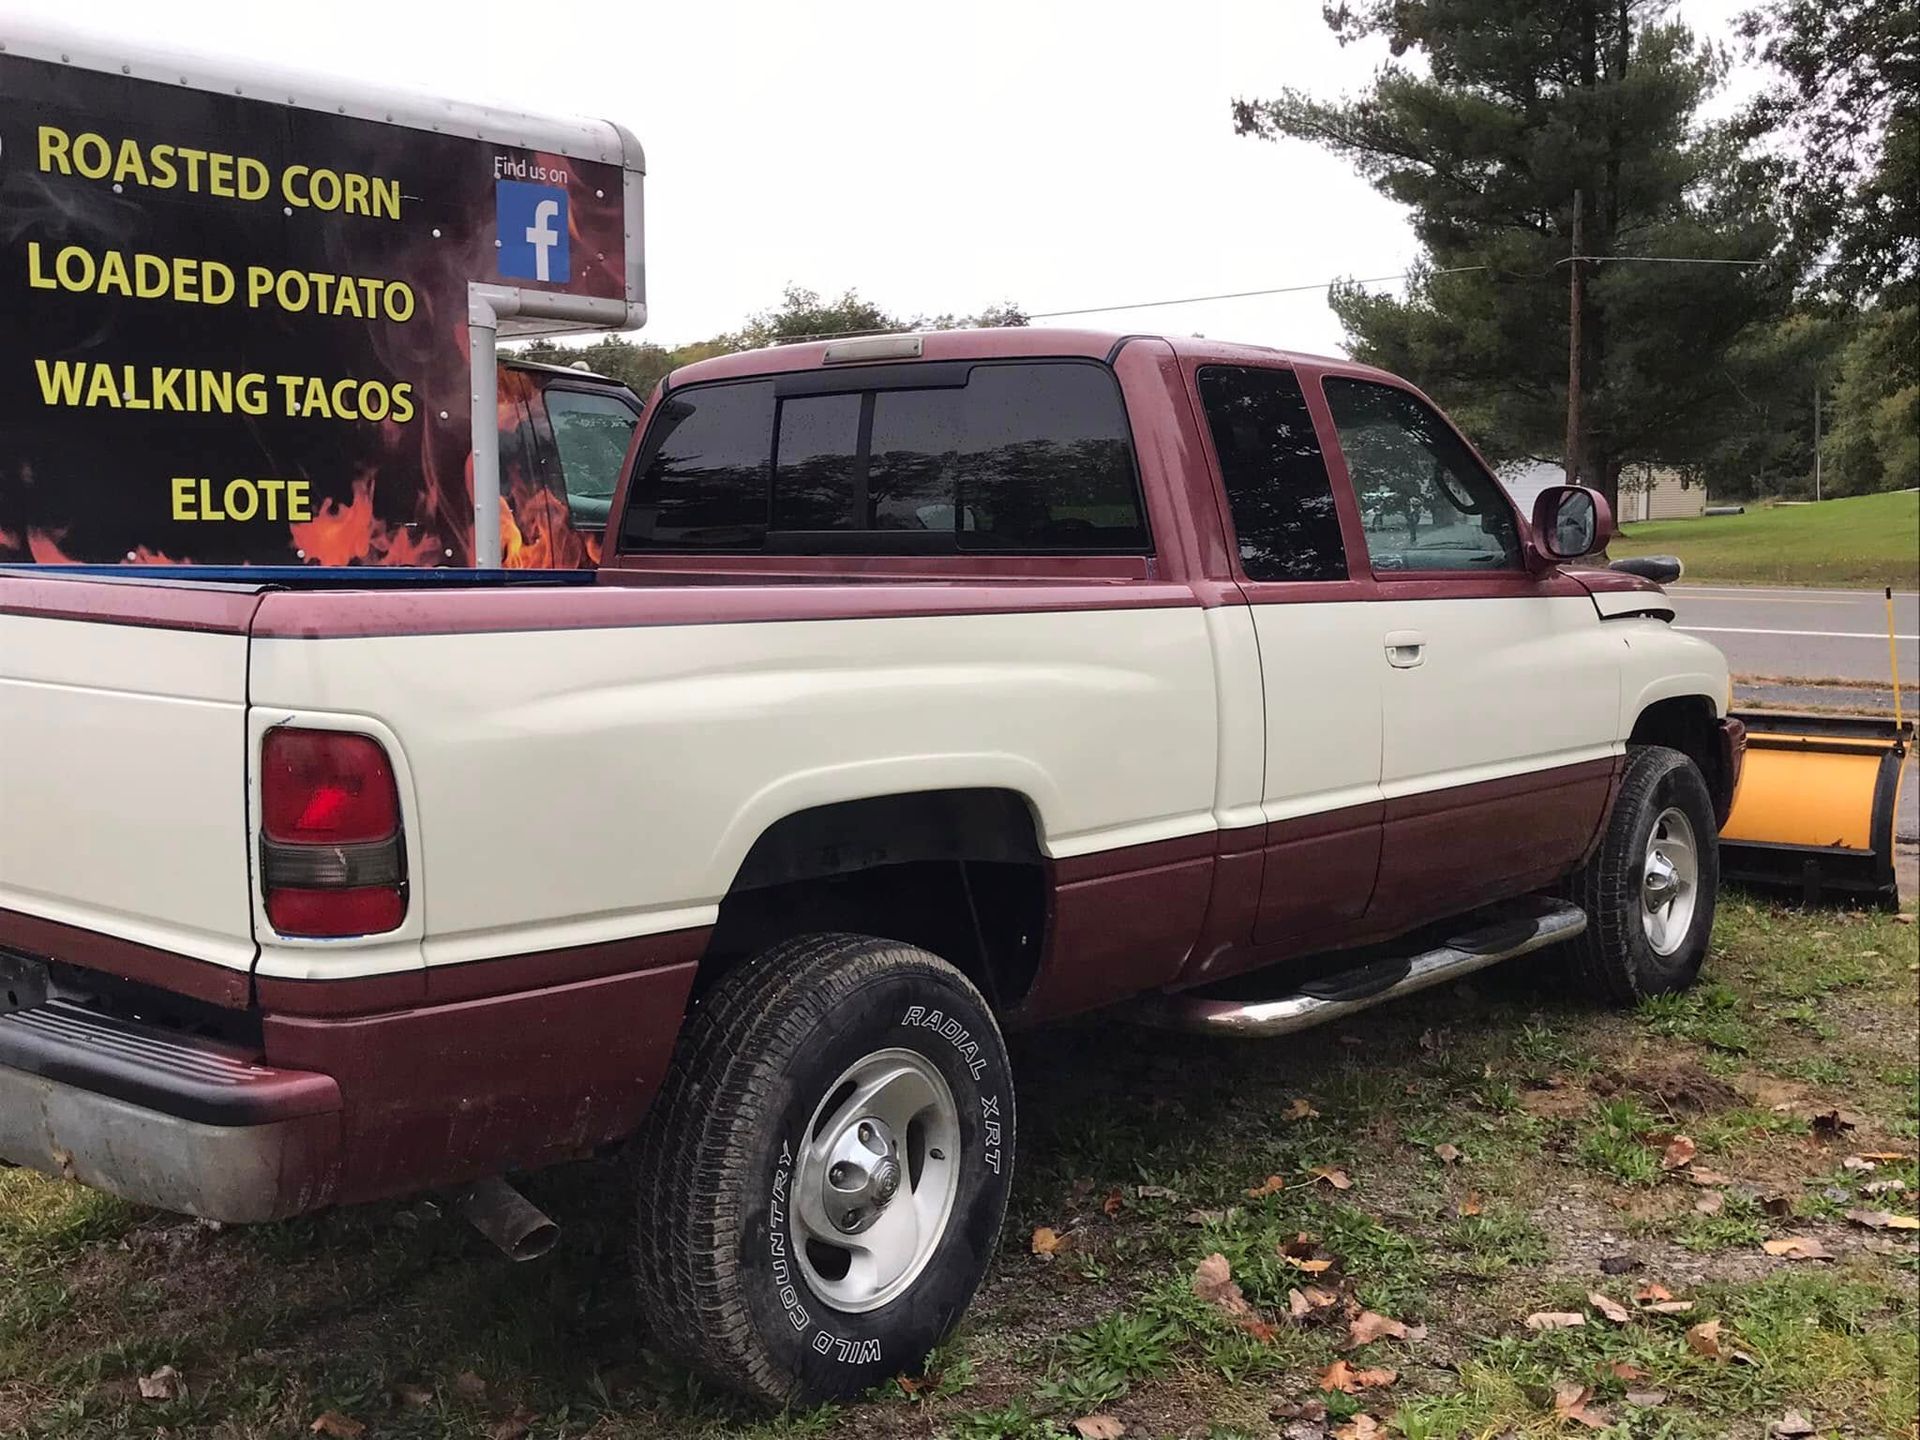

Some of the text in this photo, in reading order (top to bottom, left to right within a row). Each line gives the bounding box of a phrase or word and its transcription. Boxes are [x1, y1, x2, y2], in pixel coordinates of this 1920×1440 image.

[38, 125, 401, 220] ROASTED CORN
[494, 156, 568, 183] Find us on
[28, 242, 415, 322] LOADED POTATO
[34, 359, 415, 423] WALKING TACOS
[171, 477, 312, 521] ELOTE
[901, 1005, 1001, 1175] RADIAL XRT
[770, 1139, 881, 1364] WILD COUNTRY
